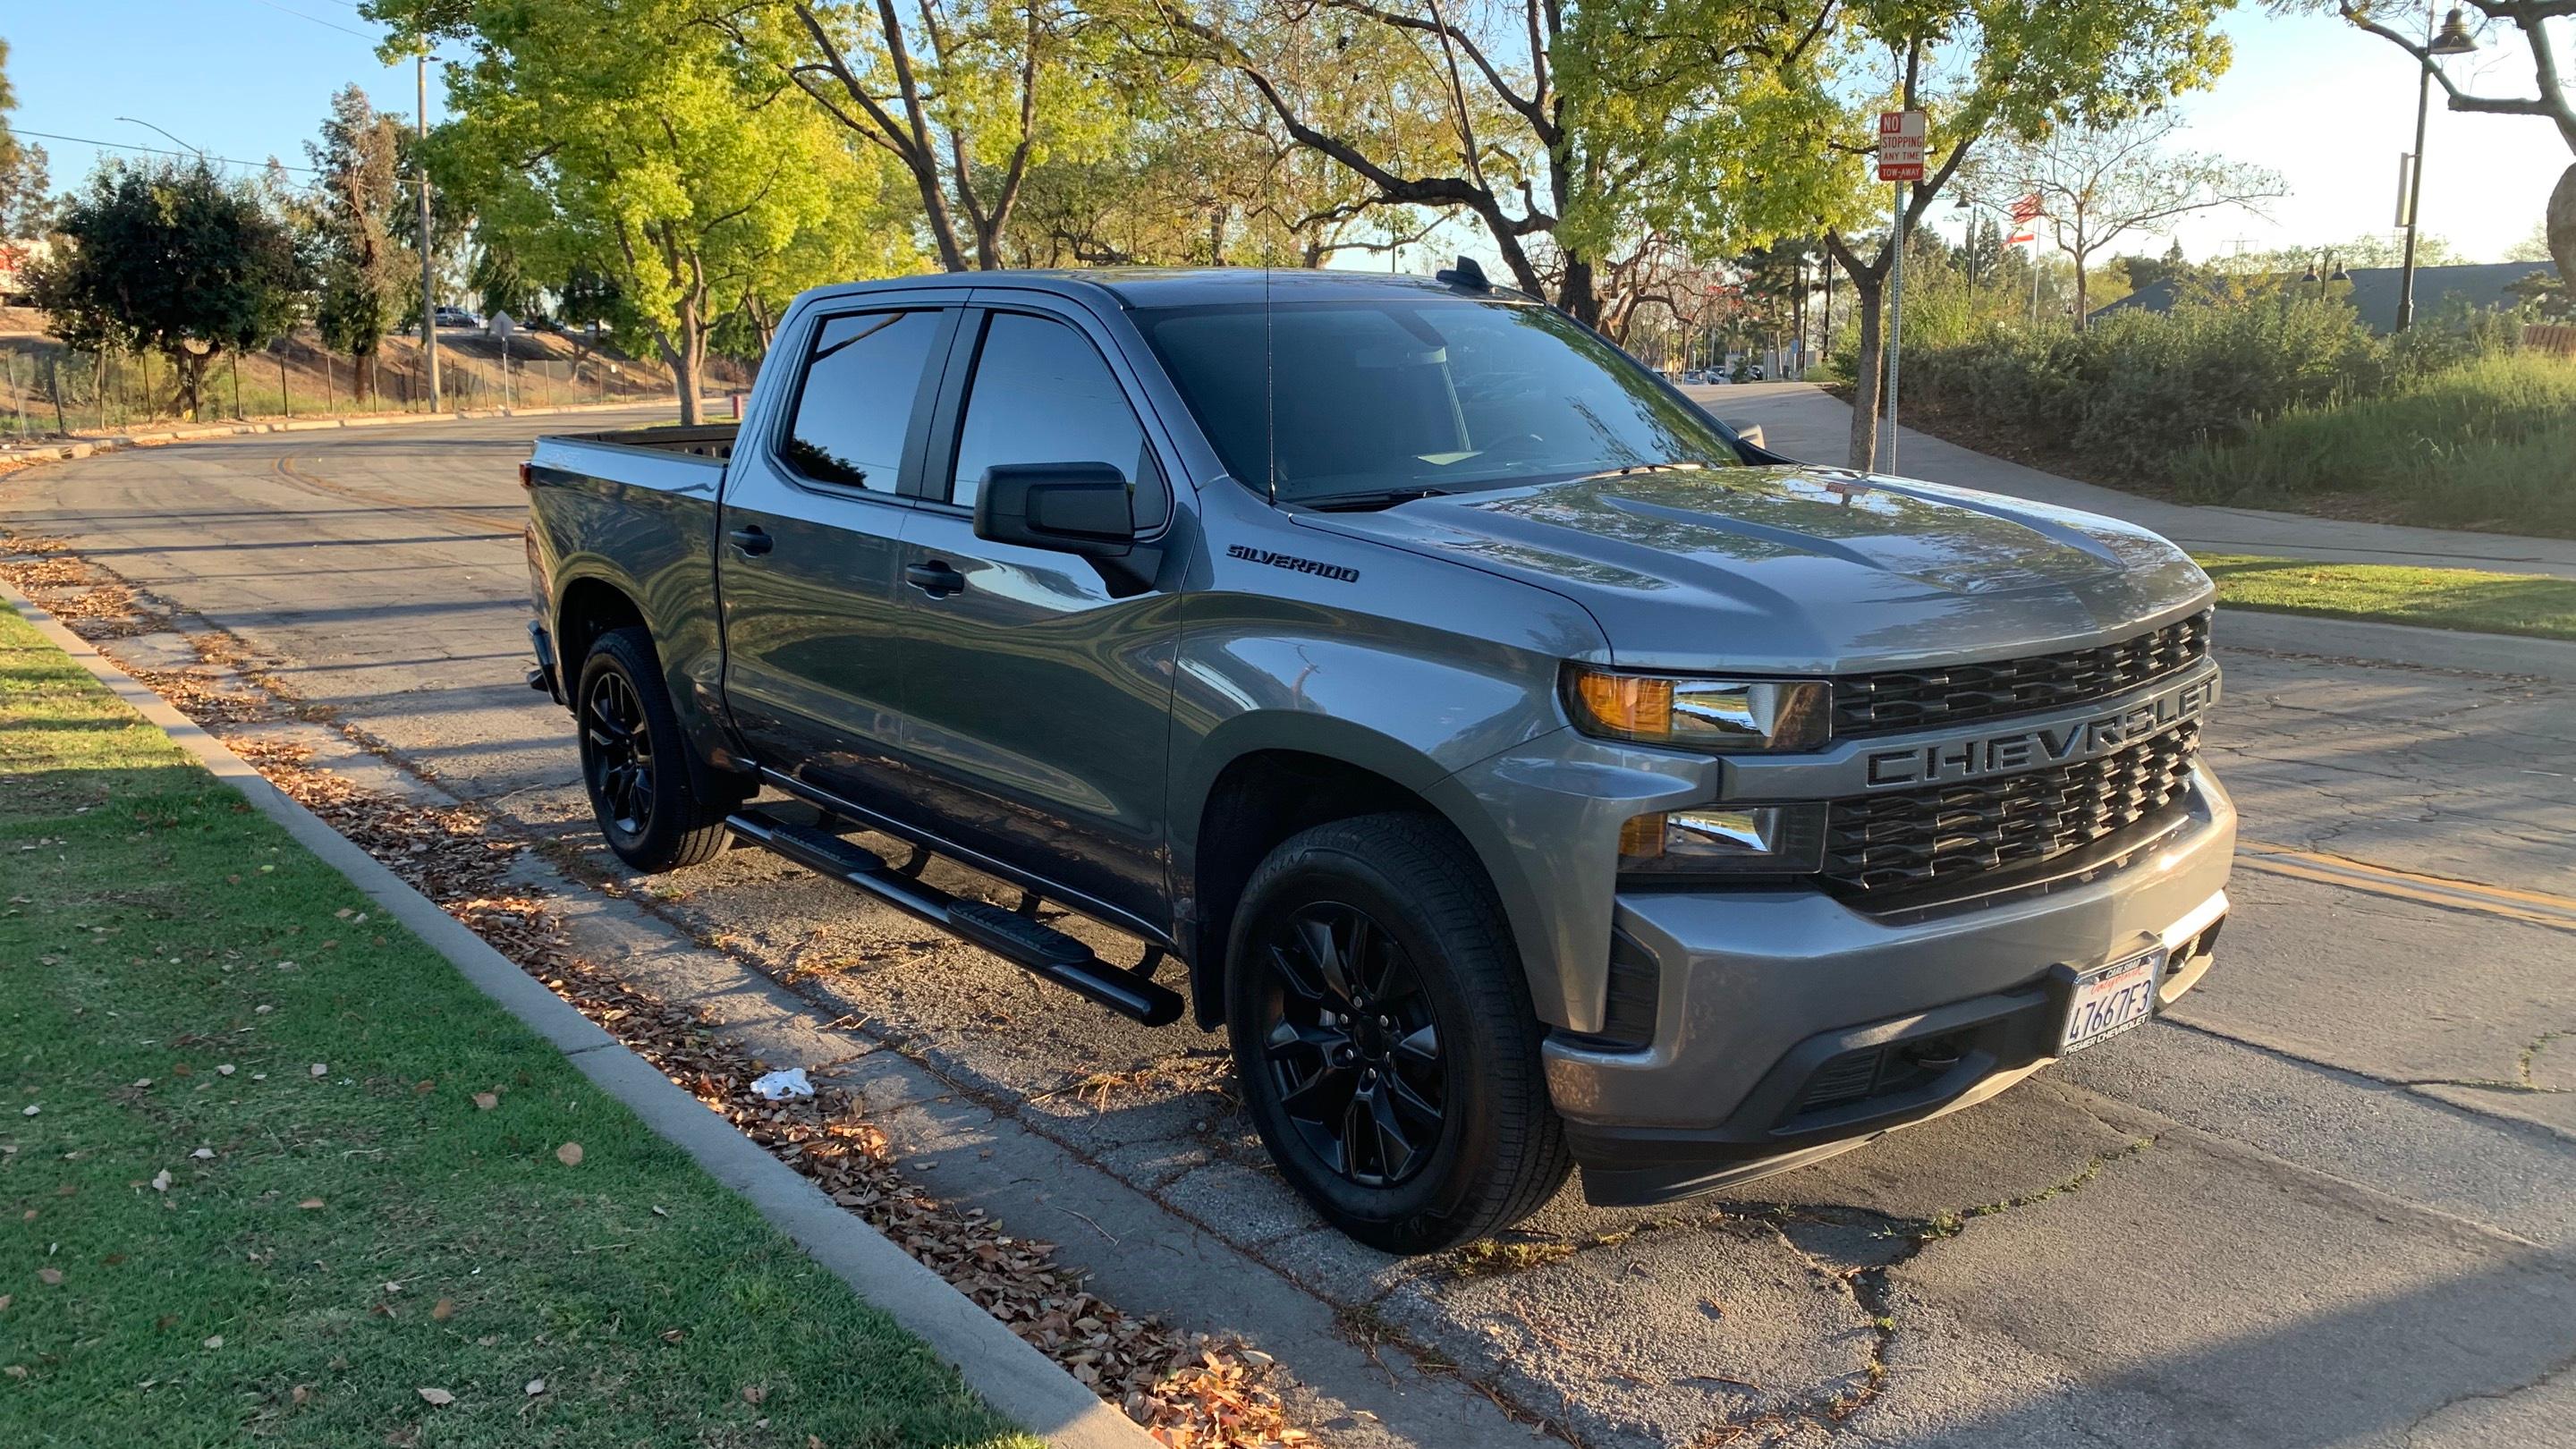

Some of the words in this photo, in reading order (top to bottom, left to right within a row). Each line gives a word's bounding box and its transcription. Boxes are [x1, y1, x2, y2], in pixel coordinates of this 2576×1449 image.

[1885, 116, 1899, 131] NO
[1884, 136, 1921, 148] STOPPING
[1884, 152, 1900, 160] ANY
[1903, 151, 1920, 160] TIME
[1884, 167, 1919, 177] TOW-AWAY
[1225, 543, 1360, 583] SILVERADO
[1866, 673, 2217, 788] CHEVROLET
[2063, 1037, 2097, 1056] PREMIER
[2097, 1015, 2148, 1043] CHEVROLET
